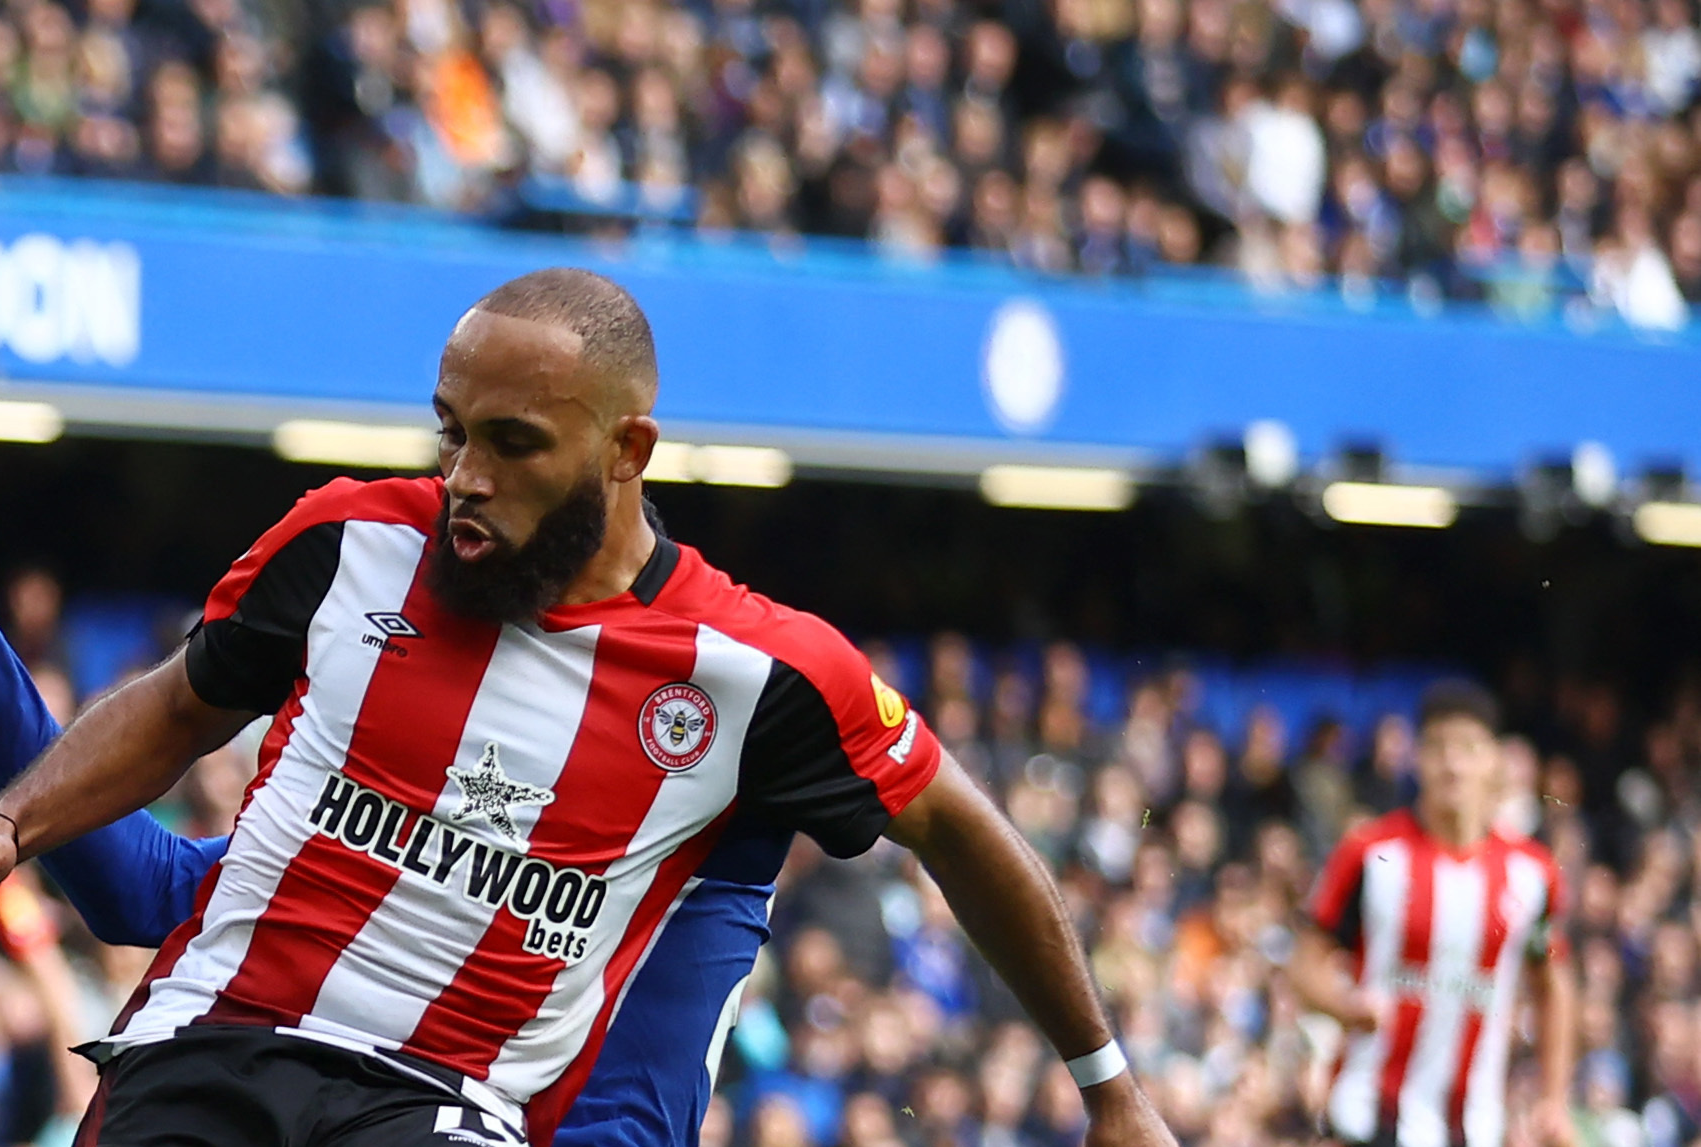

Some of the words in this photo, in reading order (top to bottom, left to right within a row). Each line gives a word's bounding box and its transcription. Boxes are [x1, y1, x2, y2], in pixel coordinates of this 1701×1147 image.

[361, 633, 408, 658] umbro
[654, 688, 710, 715] BRENTFORD
[646, 738, 679, 766] FOOTBALL
[309, 773, 608, 929] HOLLYWOOD
[526, 917, 588, 959] bets
